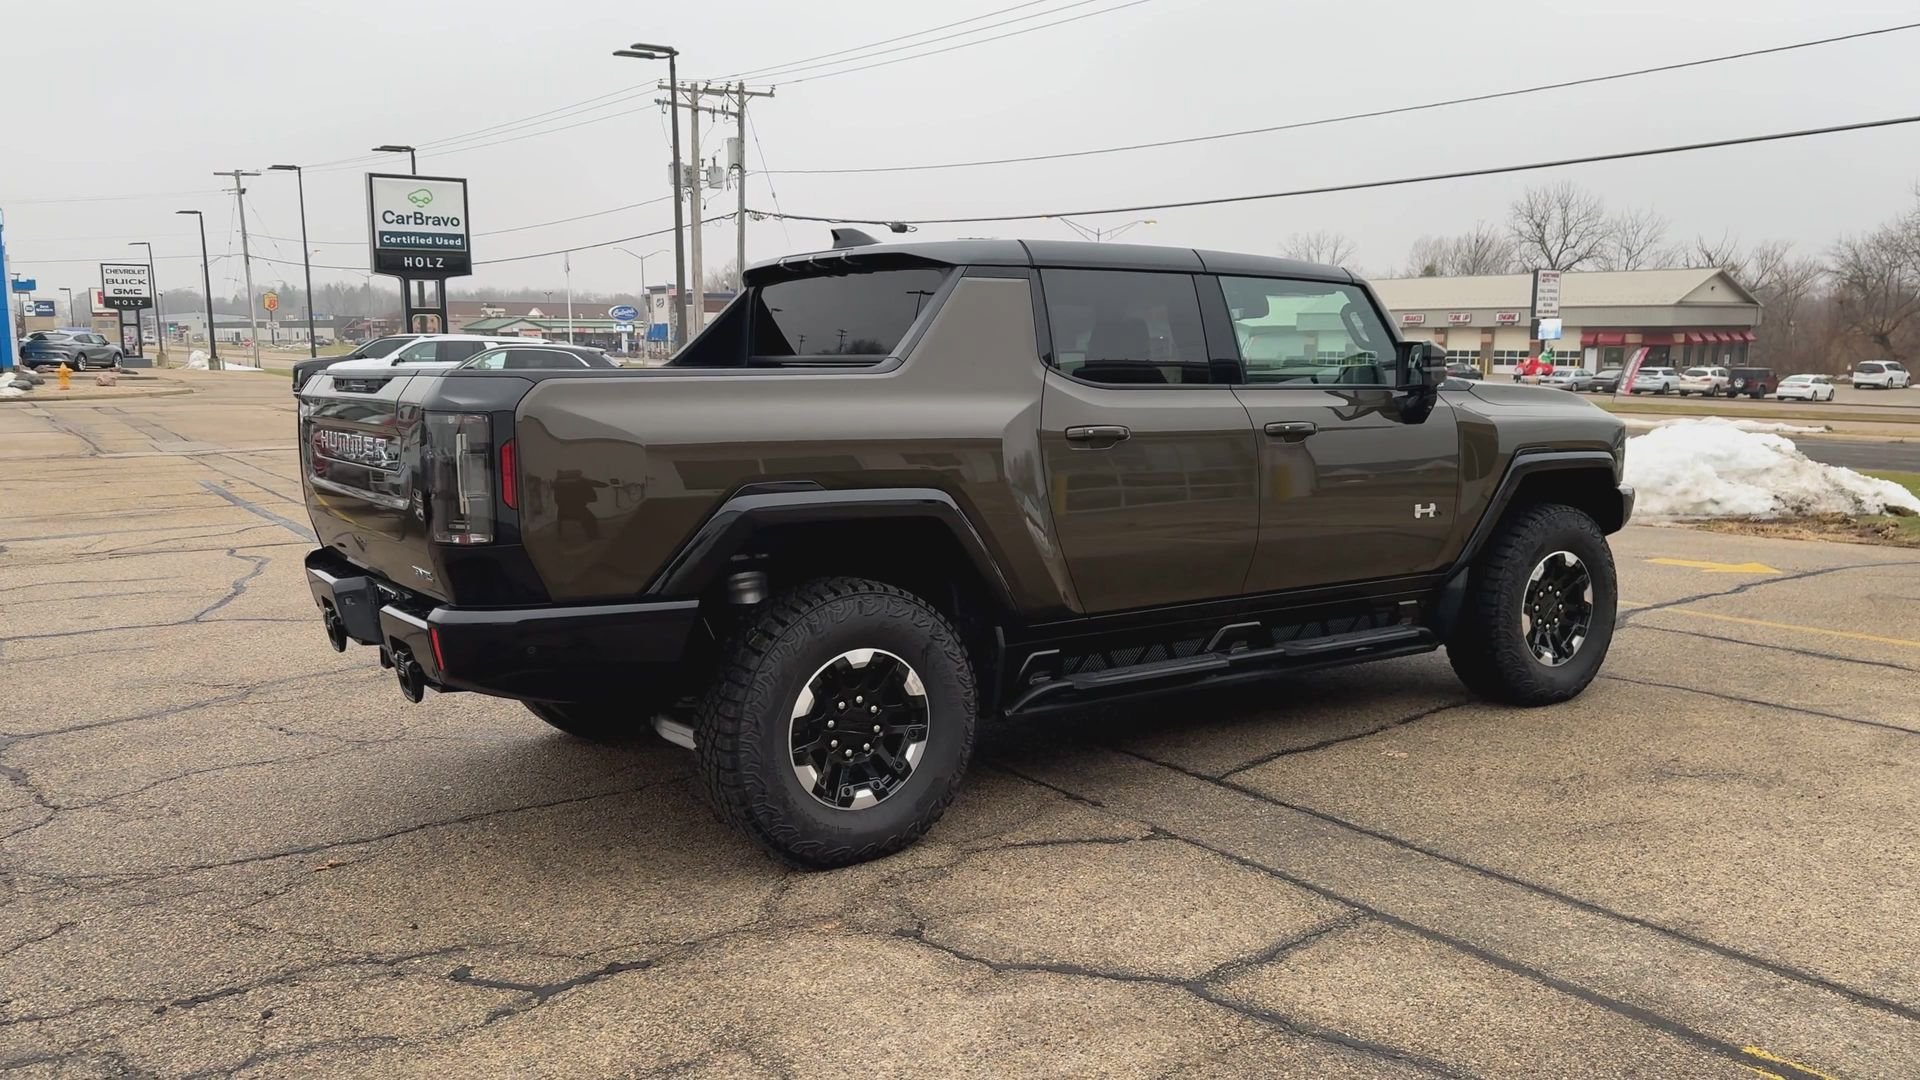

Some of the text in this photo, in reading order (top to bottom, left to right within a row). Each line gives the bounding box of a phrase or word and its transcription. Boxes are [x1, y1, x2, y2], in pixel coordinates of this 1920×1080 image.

[382, 210, 460, 227] CarBravo
[383, 235, 462, 246] Certified Used
[404, 256, 444, 268] HOLZ
[320, 429, 388, 460] HUMMER
